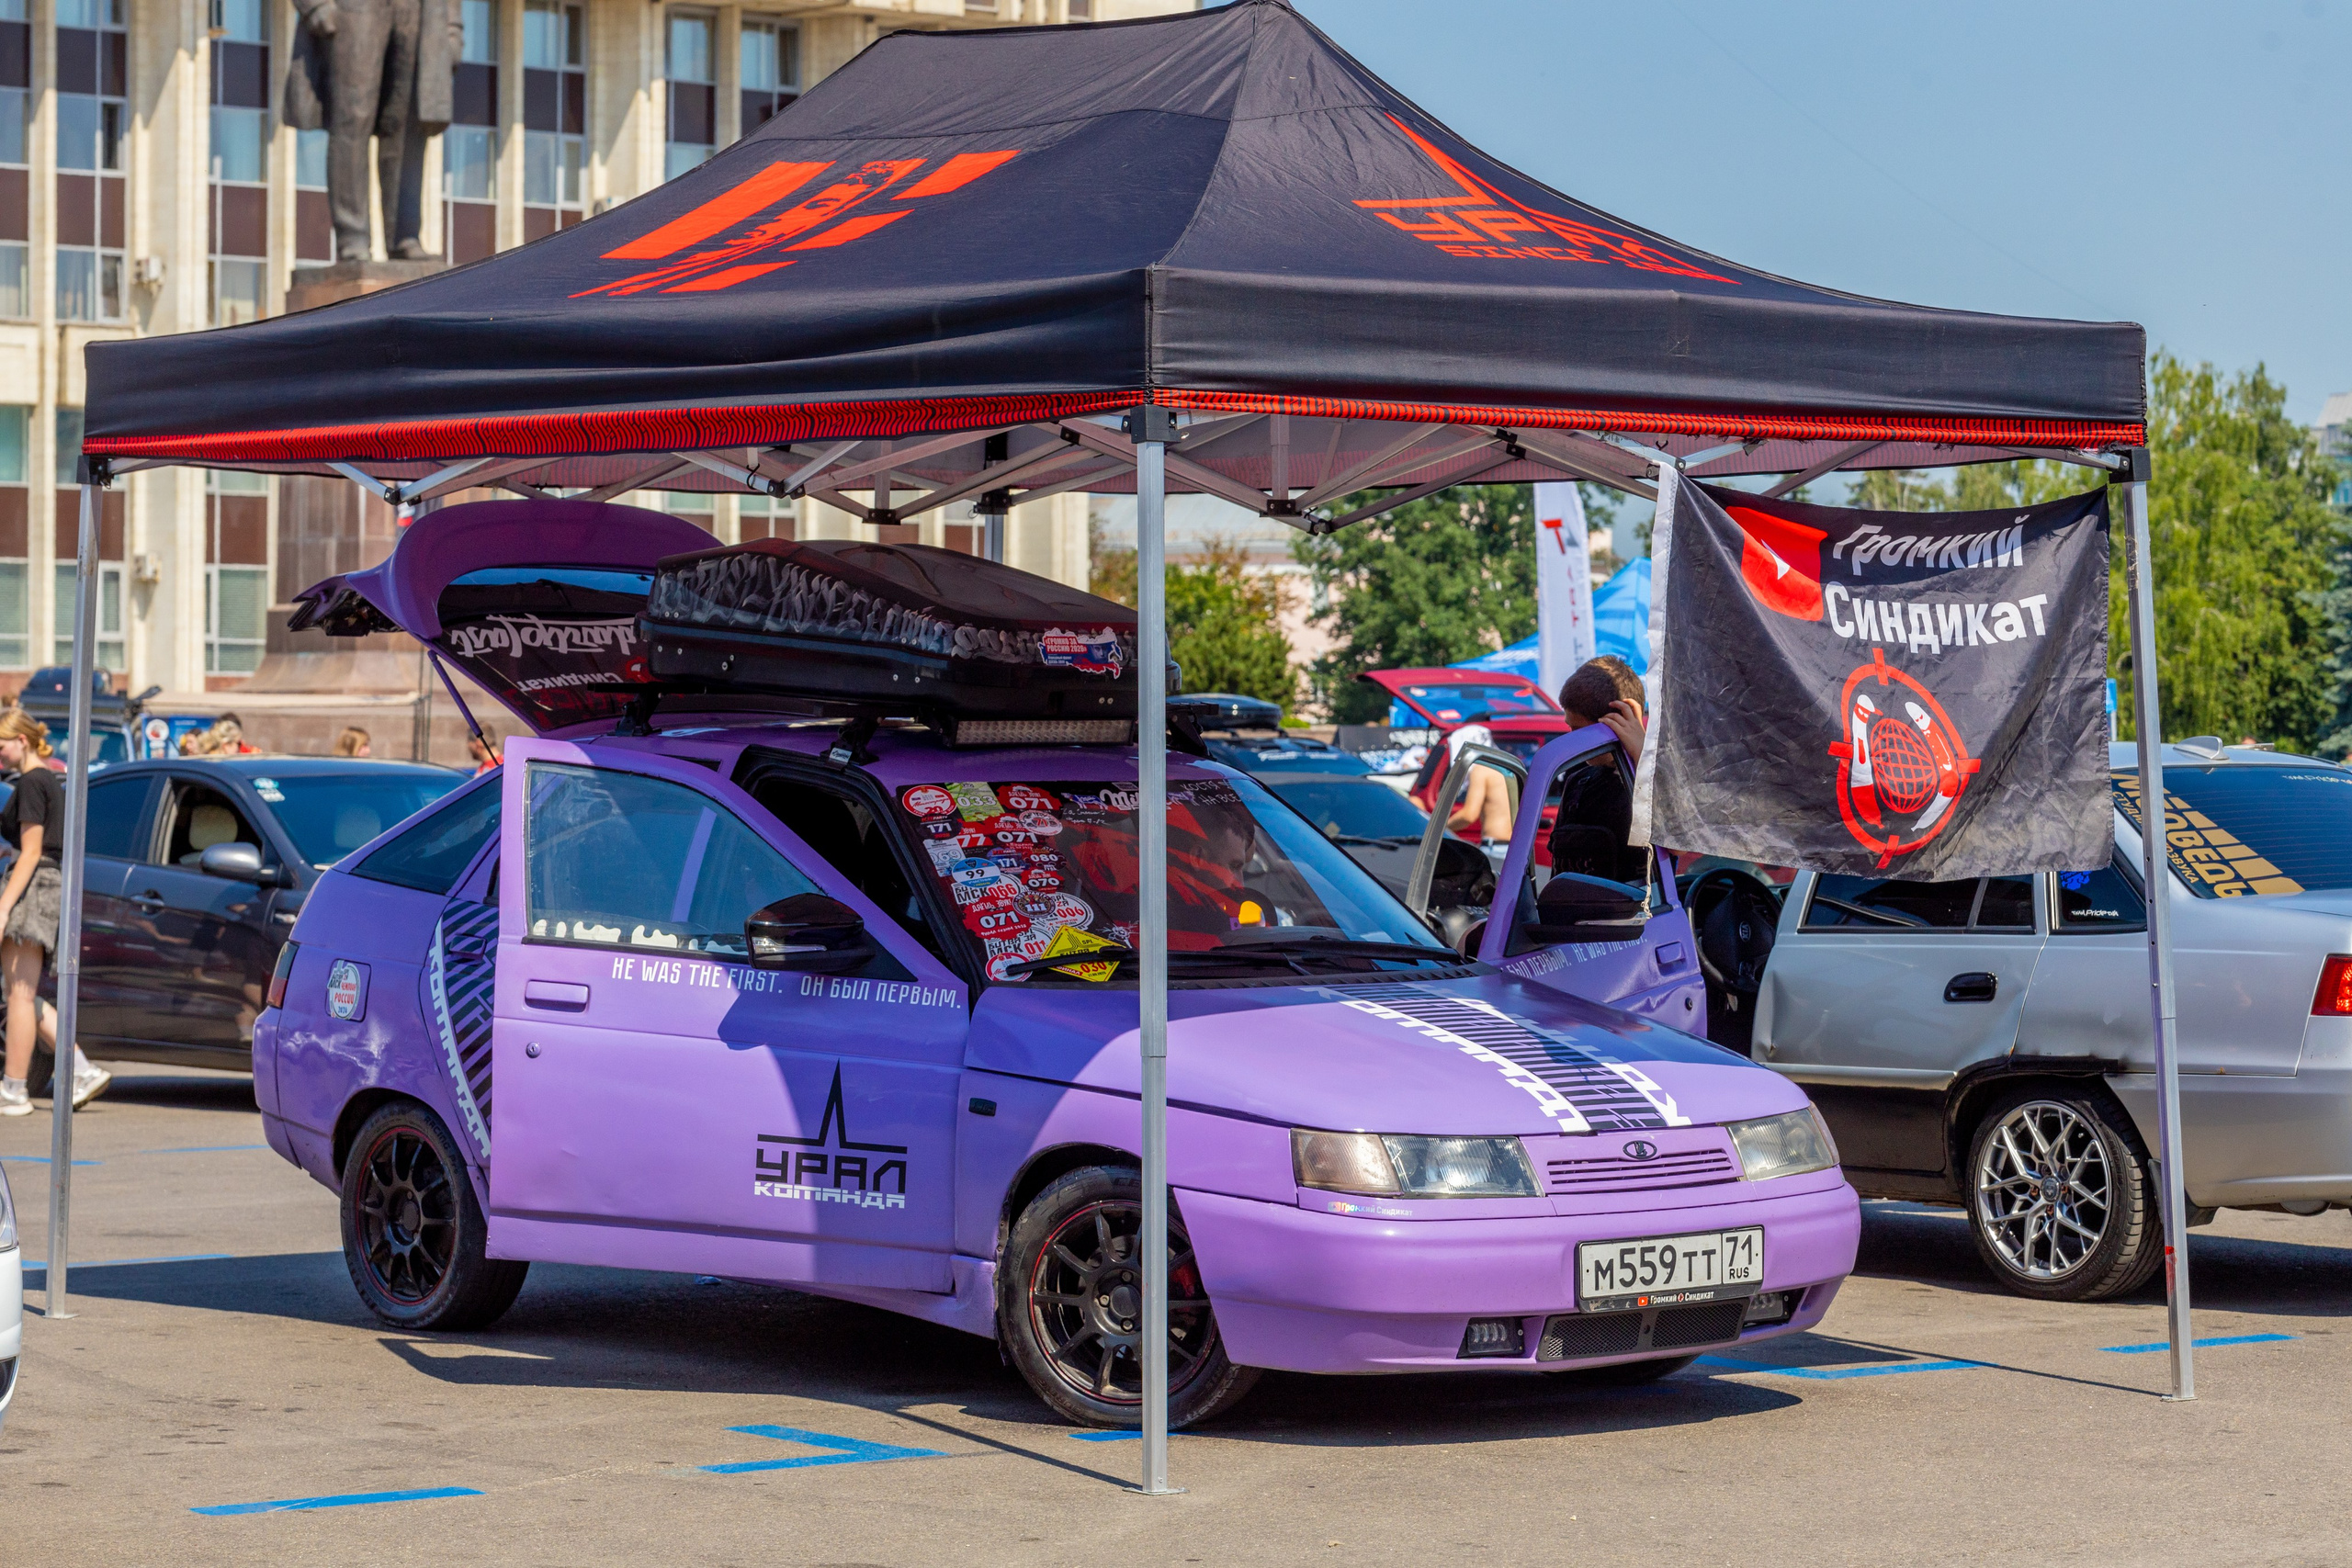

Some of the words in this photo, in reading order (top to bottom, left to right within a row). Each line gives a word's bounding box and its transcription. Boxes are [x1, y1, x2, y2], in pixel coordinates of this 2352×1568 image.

[1434, 244, 1611, 265] SINCE
[1832, 513, 2030, 576] Громкий
[1825, 581, 2049, 654] Синдикат
[517, 672, 623, 692] Синдикат
[957, 795, 997, 807] 033
[1009, 796, 1054, 809] 071
[2112, 791, 2142, 824] СТУДИ
[926, 822, 952, 833] 171
[997, 830, 1038, 843] 071
[998, 857, 1018, 867] 171
[2165, 842, 2199, 884] ОЗВУКА
[966, 869, 985, 879] 99
[1028, 877, 1060, 887] 070
[956, 887, 989, 904] МСК
[989, 883, 1017, 898] 066
[1024, 903, 1046, 912] 111
[1057, 907, 1085, 918] 006
[979, 910, 1020, 930] 071
[1571, 942, 1588, 963] HE
[1080, 961, 1108, 974] 030
[612, 957, 633, 980] HE
[642, 960, 682, 986] WAS
[689, 964, 720, 989] THE
[727, 967, 783, 994] FIRST.
[800, 975, 824, 997] ОН
[830, 977, 869, 1000] БЫЛ
[876, 982, 962, 1010] ПЕРВЫМ.
[755, 1148, 907, 1194] УРАЛ
[754, 1181, 906, 1210] КОМАНДА
[1341, 1202, 1375, 1213] Громкий
[1376, 1206, 1413, 1216] Синдикат
[1725, 1234, 1753, 1268] 71
[1728, 1267, 1749, 1280] RUS
[1650, 1293, 1677, 1304] Громкий
[1684, 1291, 1714, 1302] Синдикат
